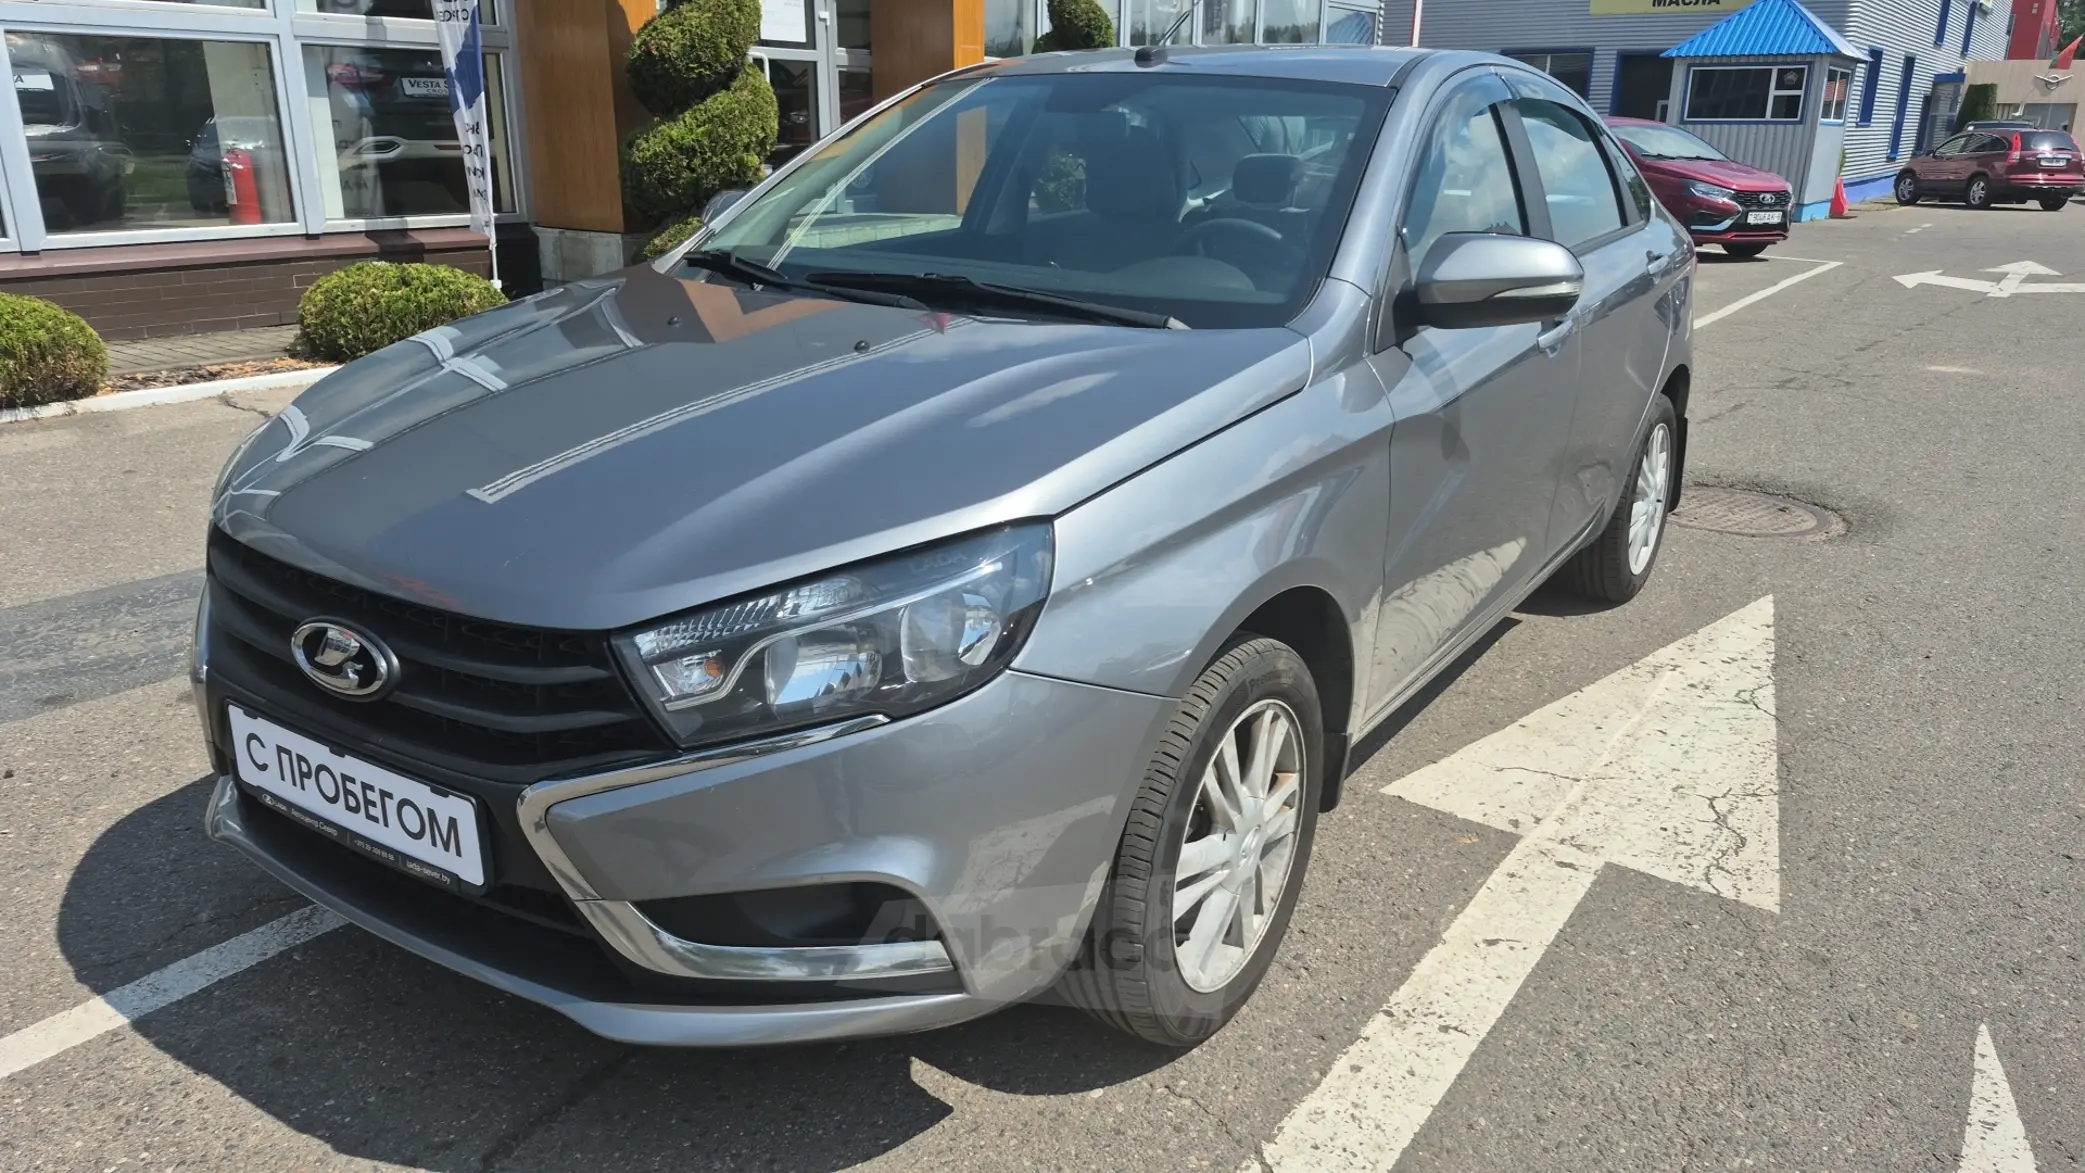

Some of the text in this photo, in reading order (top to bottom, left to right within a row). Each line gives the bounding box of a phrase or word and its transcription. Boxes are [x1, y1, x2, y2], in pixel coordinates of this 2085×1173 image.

[408, 79, 440, 89] VESTA
[246, 732, 462, 858] С ПРОБЕГОМ
